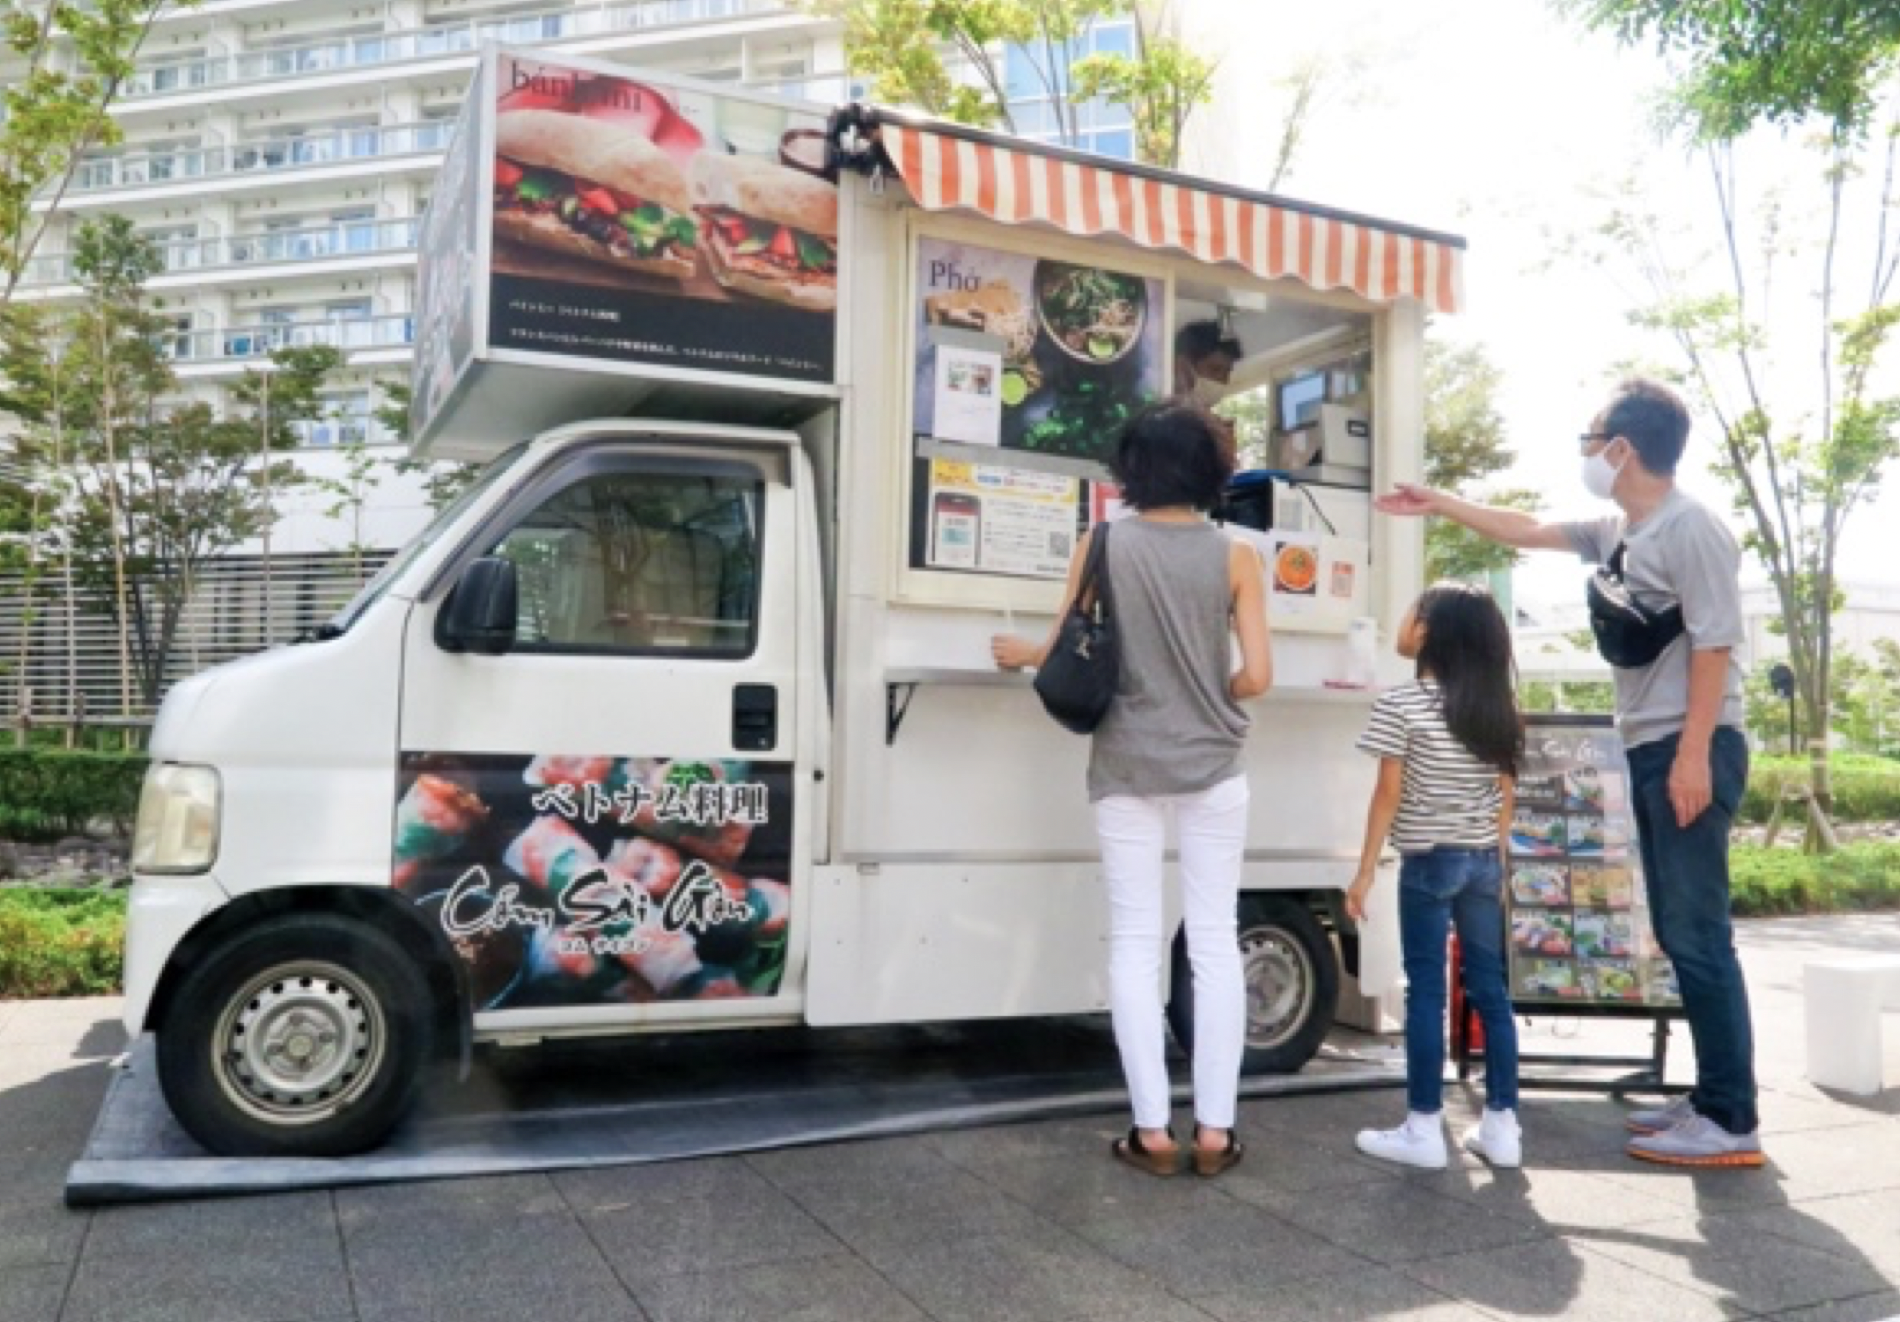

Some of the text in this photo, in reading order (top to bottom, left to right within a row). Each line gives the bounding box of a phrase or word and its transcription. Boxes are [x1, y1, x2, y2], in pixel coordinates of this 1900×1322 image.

[532, 780, 768, 824] ベトナム料理
